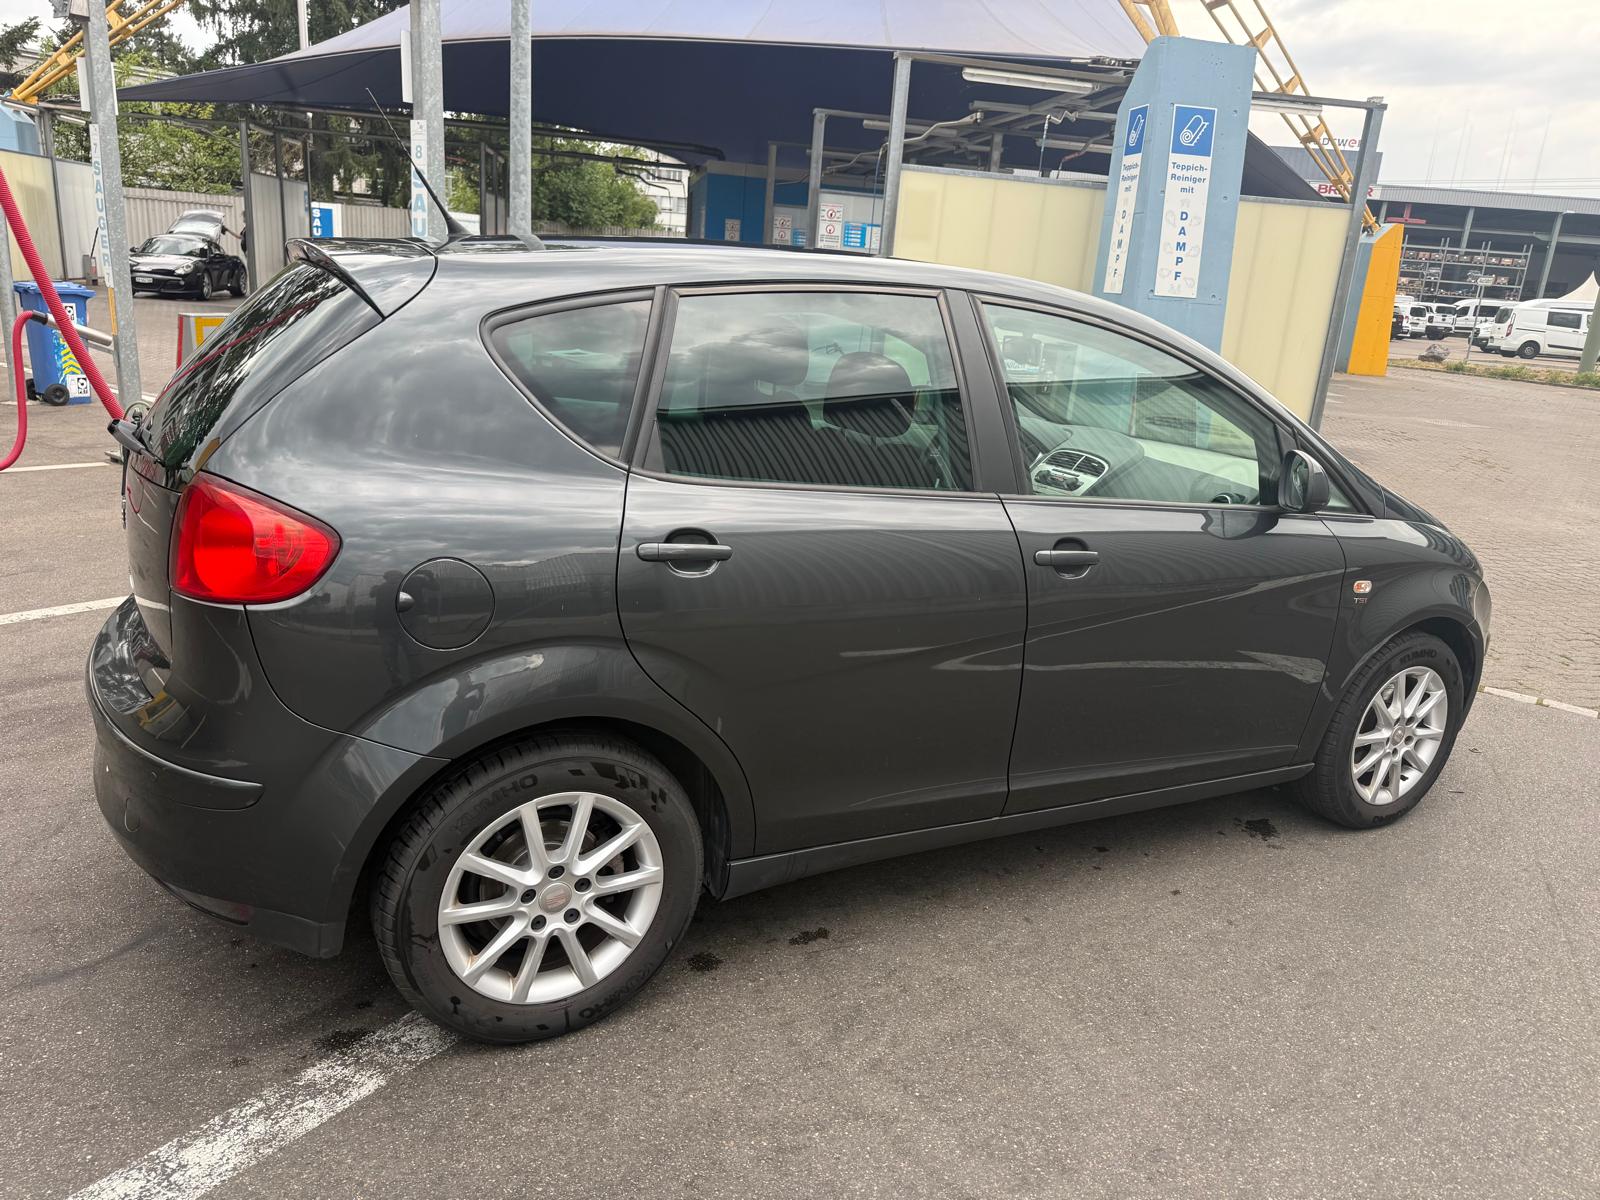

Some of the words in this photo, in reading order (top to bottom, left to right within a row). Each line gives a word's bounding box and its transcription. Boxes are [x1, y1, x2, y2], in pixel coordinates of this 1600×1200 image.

[415, 145, 423, 159] 8
[1123, 162, 1140, 172] Teppich-
[1171, 161, 1208, 172] Teppich-
[1121, 173, 1138, 183] Reiniger
[1170, 173, 1207, 184] Reiniger
[1179, 186, 1195, 194] mit
[93, 160, 111, 267] SAUGER
[312, 208, 322, 236] SAU
[1113, 209, 1127, 278] DAMPF
[1174, 211, 1189, 281] DAMPF
